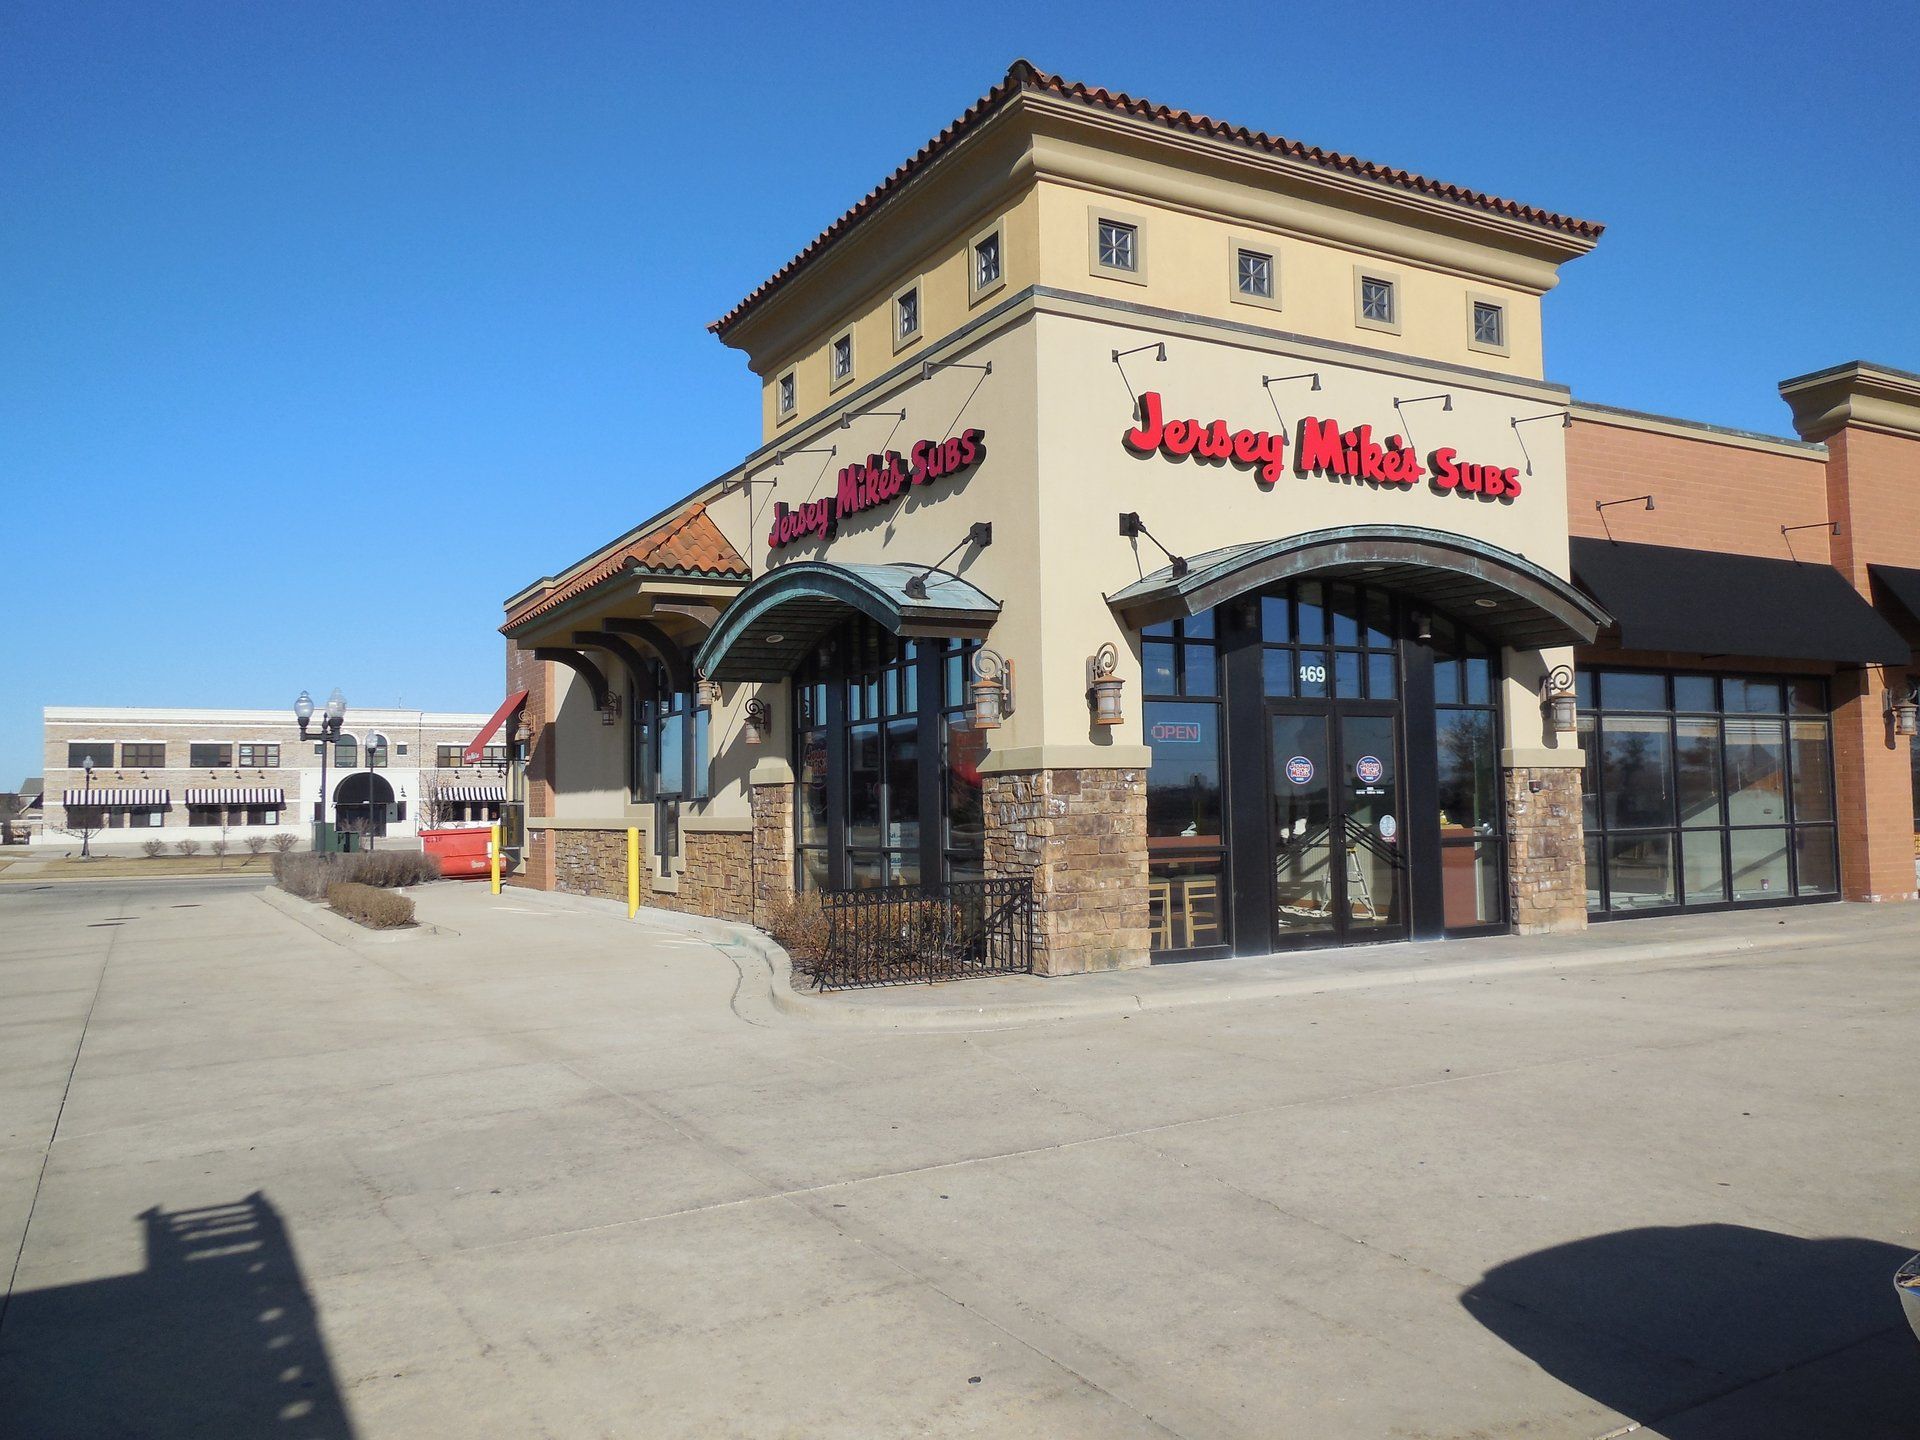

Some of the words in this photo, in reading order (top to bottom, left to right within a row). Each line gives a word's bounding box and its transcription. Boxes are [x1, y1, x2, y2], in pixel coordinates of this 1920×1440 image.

[1124, 391, 1285, 484] Jersey
[1295, 416, 1426, 485] Mike's
[768, 501, 835, 548] Jersey
[836, 450, 908, 519] Mike's
[1299, 666, 1326, 682] 469
[1152, 726, 1197, 739] OPEN
